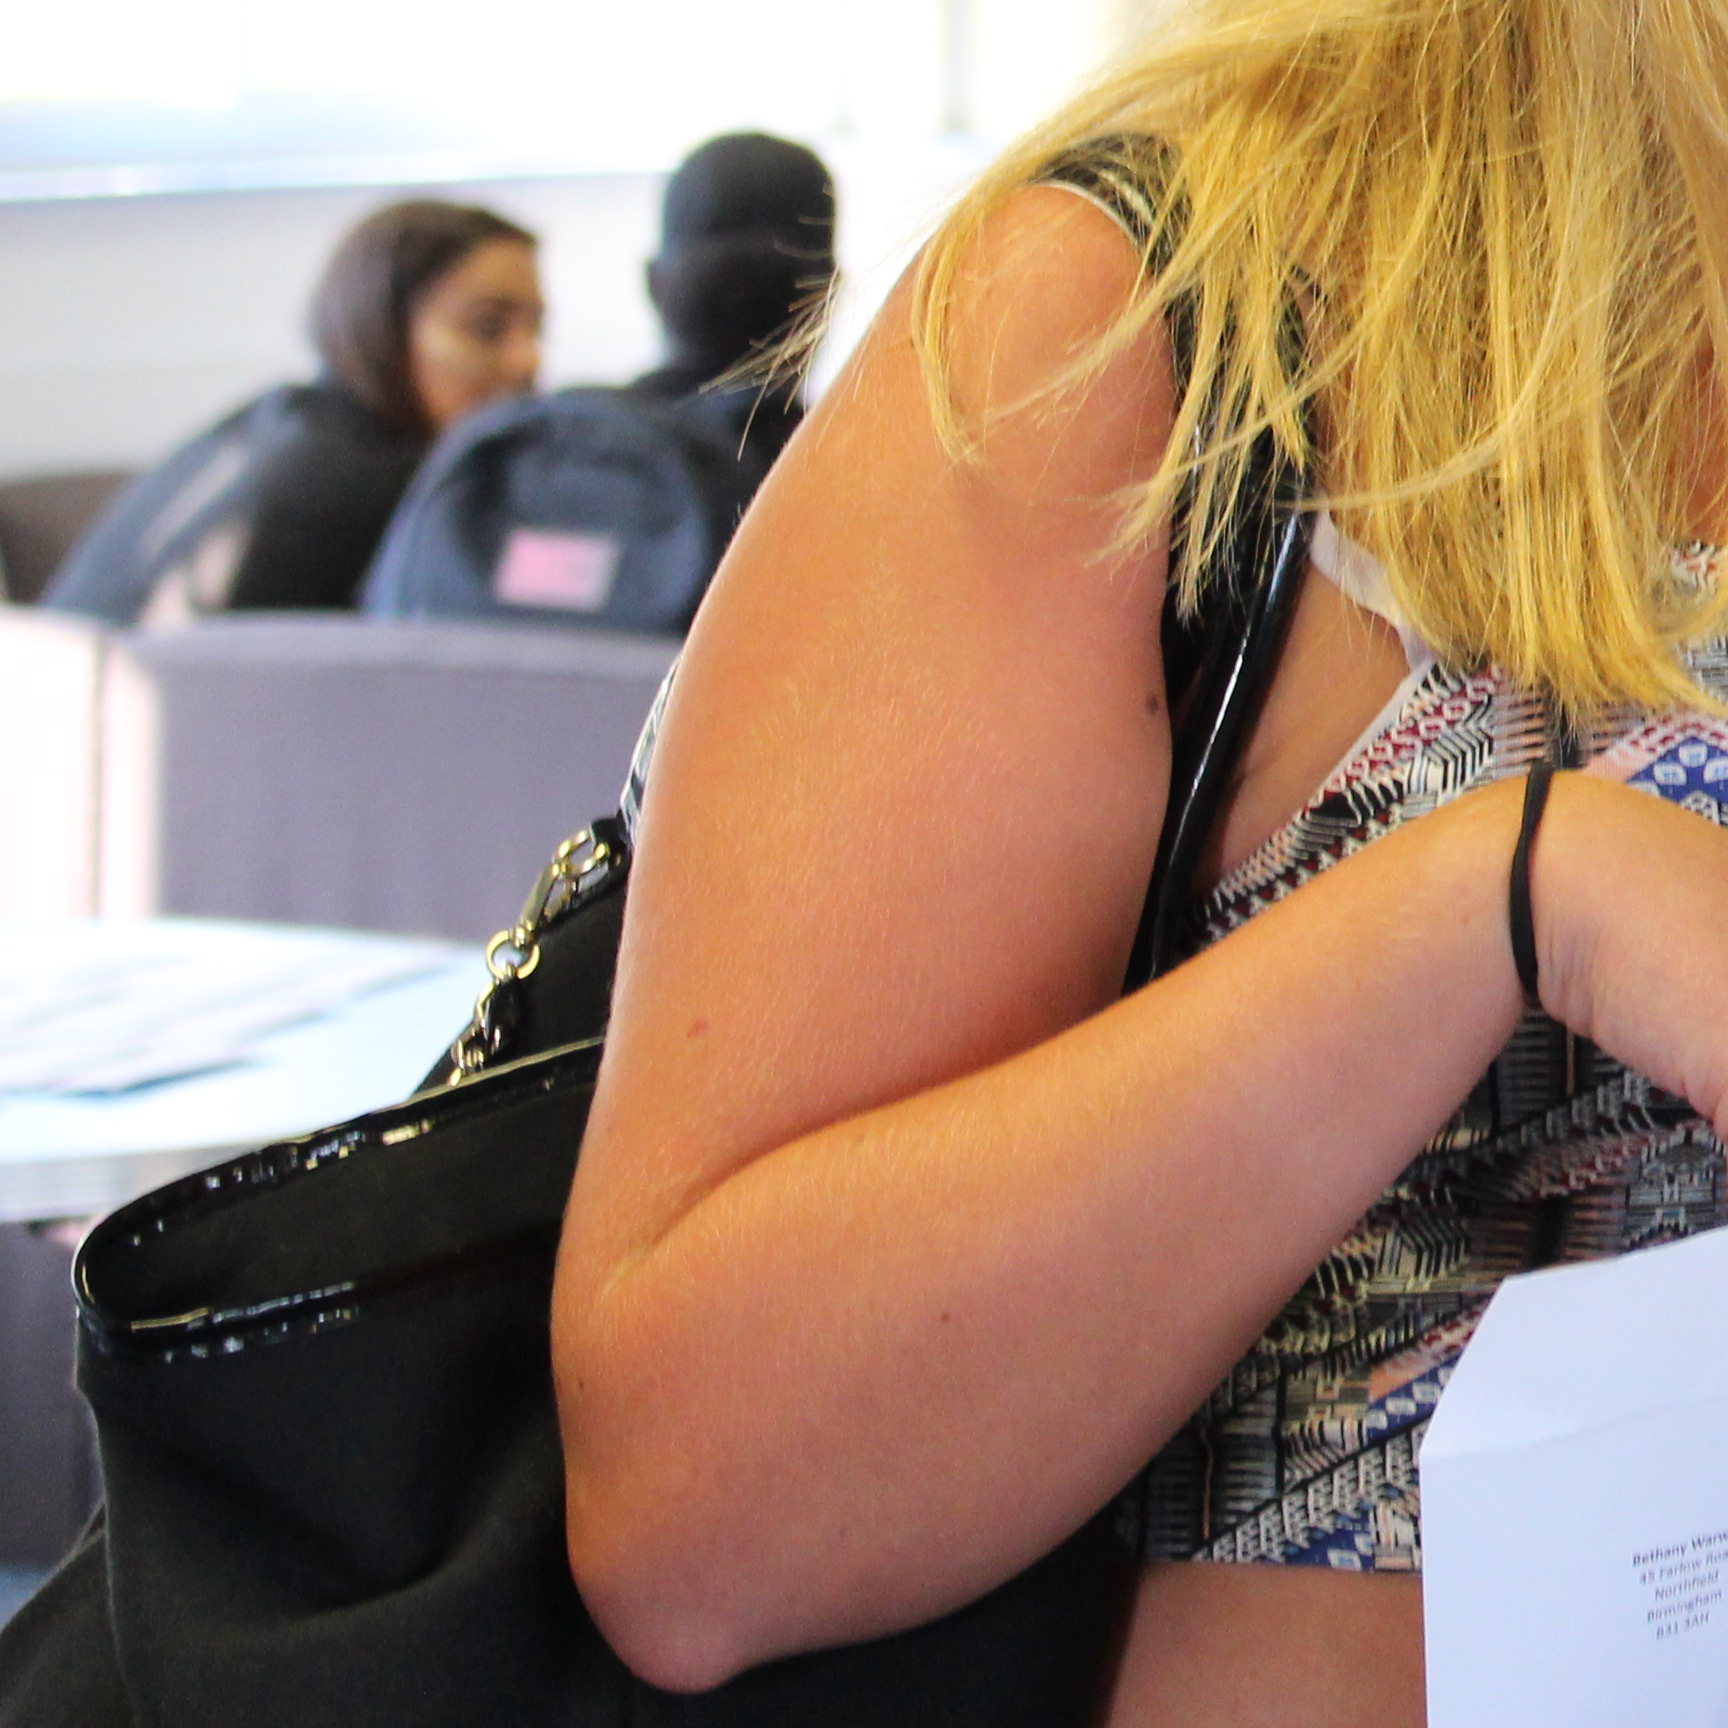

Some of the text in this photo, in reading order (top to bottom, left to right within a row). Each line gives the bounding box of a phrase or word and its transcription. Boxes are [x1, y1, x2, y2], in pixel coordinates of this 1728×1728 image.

[1633, 1544, 1687, 1568] Bethany
[1655, 1568, 1719, 1601] Northfield
[1647, 1588, 1722, 1624] Birmingham
